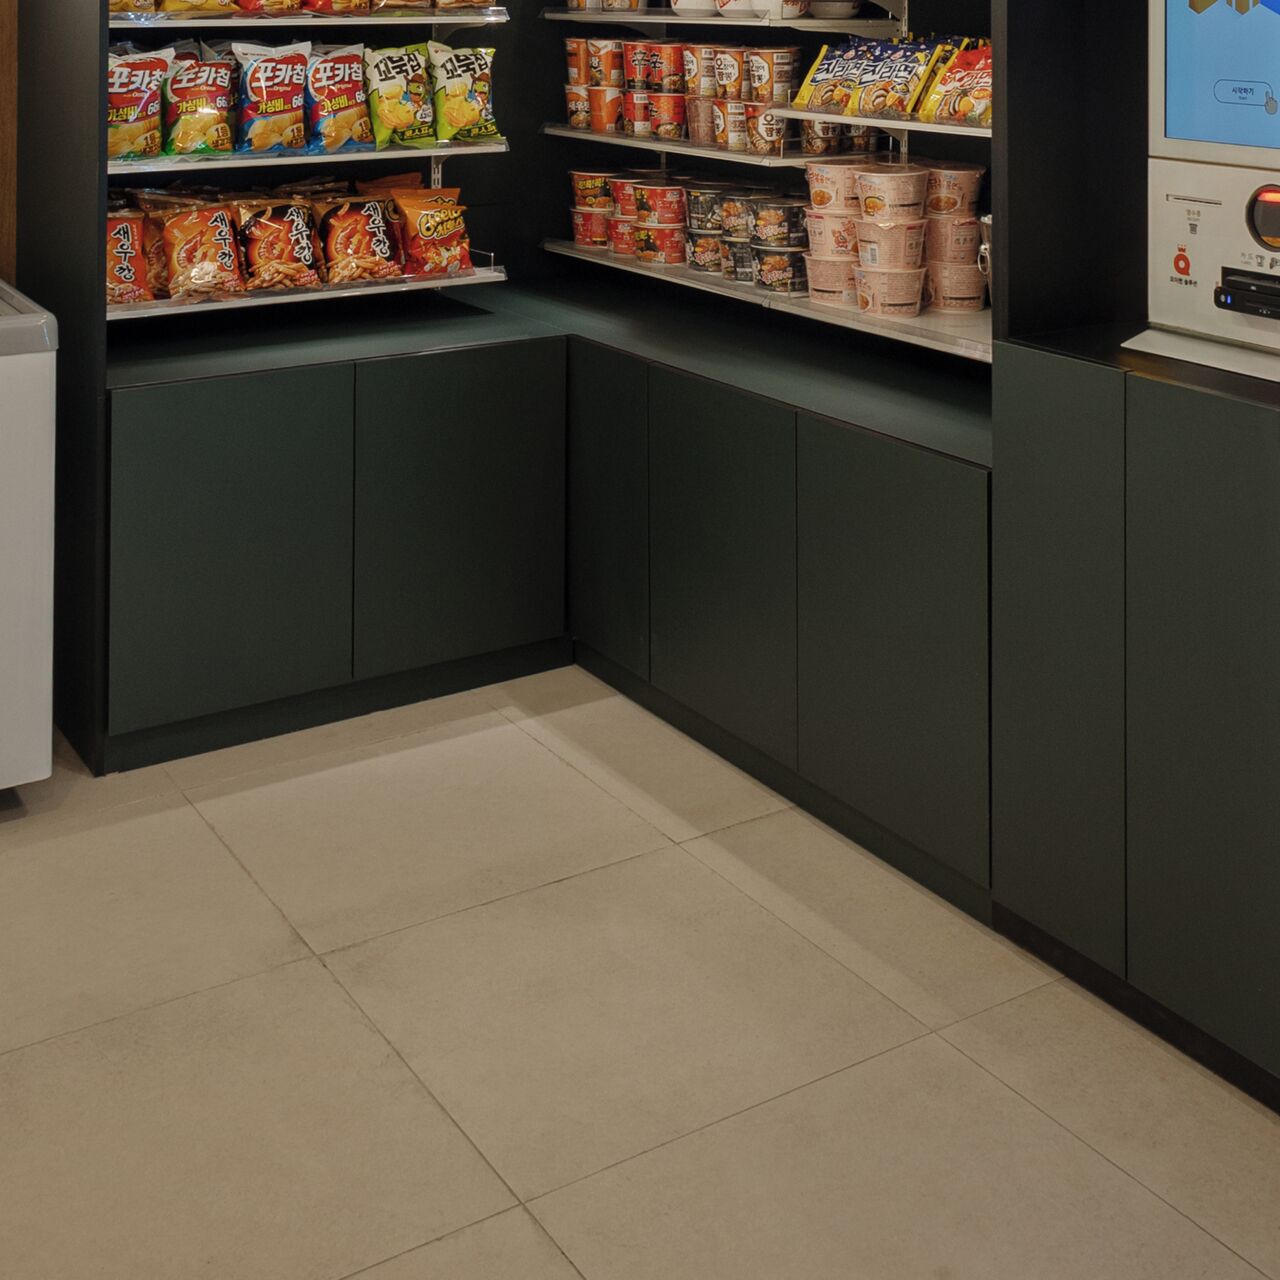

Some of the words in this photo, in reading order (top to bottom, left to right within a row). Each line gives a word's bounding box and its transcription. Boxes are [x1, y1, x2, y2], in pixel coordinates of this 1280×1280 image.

[251, 61, 306, 89] 포카칩
[313, 61, 364, 89] 포카칩
[373, 52, 422, 82] 꼬북칩
[440, 52, 490, 81] 꼬북칩
[176, 97, 207, 114] 가성비
[257, 98, 284, 114] 가성비
[208, 210, 236, 271] 새우깡
[283, 206, 313, 265] 새우깡
[361, 201, 390, 258] 새우깡
[110, 222, 136, 282] 새우깡
